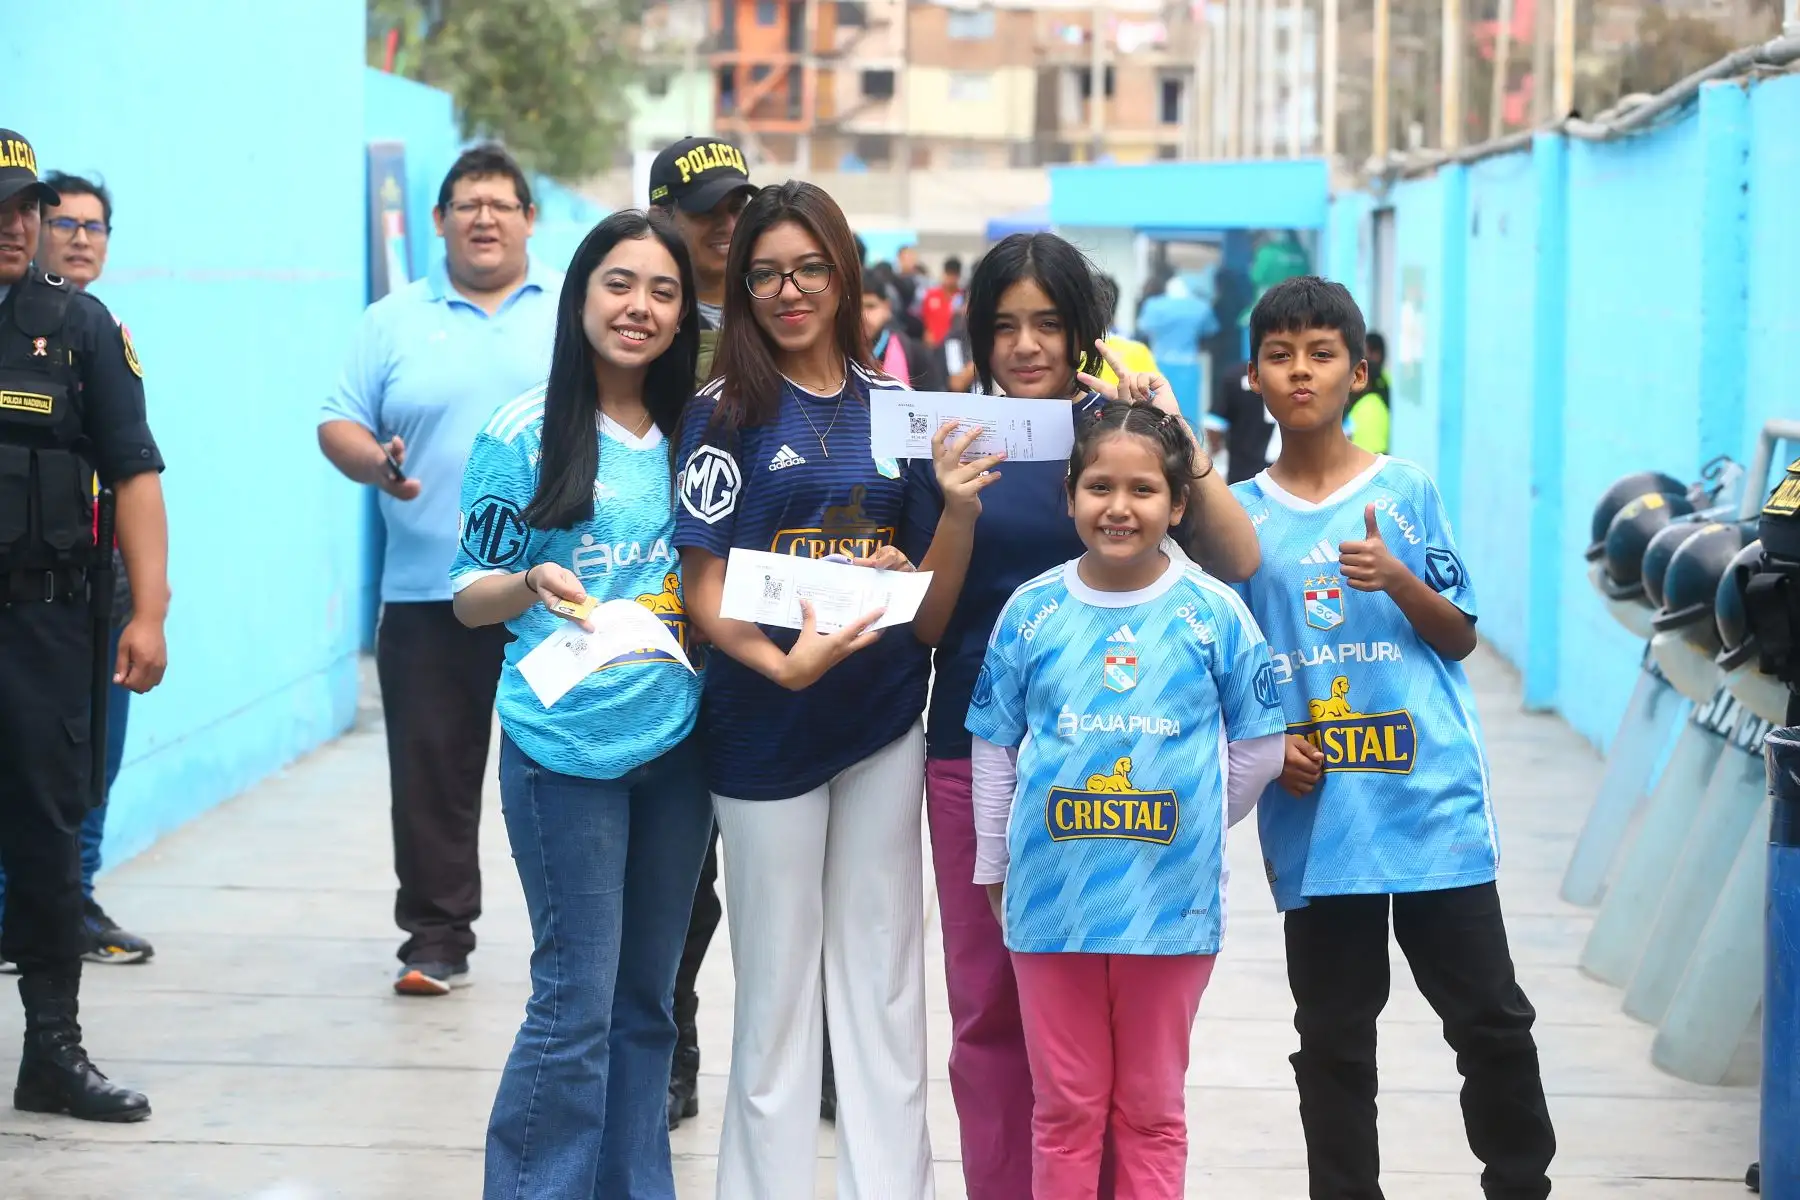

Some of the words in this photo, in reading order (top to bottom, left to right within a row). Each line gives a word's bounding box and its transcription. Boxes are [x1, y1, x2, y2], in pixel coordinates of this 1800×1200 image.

[674, 143, 748, 183] POLICIA
[3, 395, 22, 405] POLICIA
[23, 397, 49, 409] NACIONAL
[768, 456, 806, 472] adidas
[684, 453, 735, 517] MG
[465, 502, 525, 565] MG
[613, 538, 672, 567] CAJA
[1338, 641, 1404, 663] PIURA
[1080, 713, 1126, 733] CAJA
[1128, 715, 1181, 738] PIURA
[1055, 798, 1168, 831] CRISTAL
